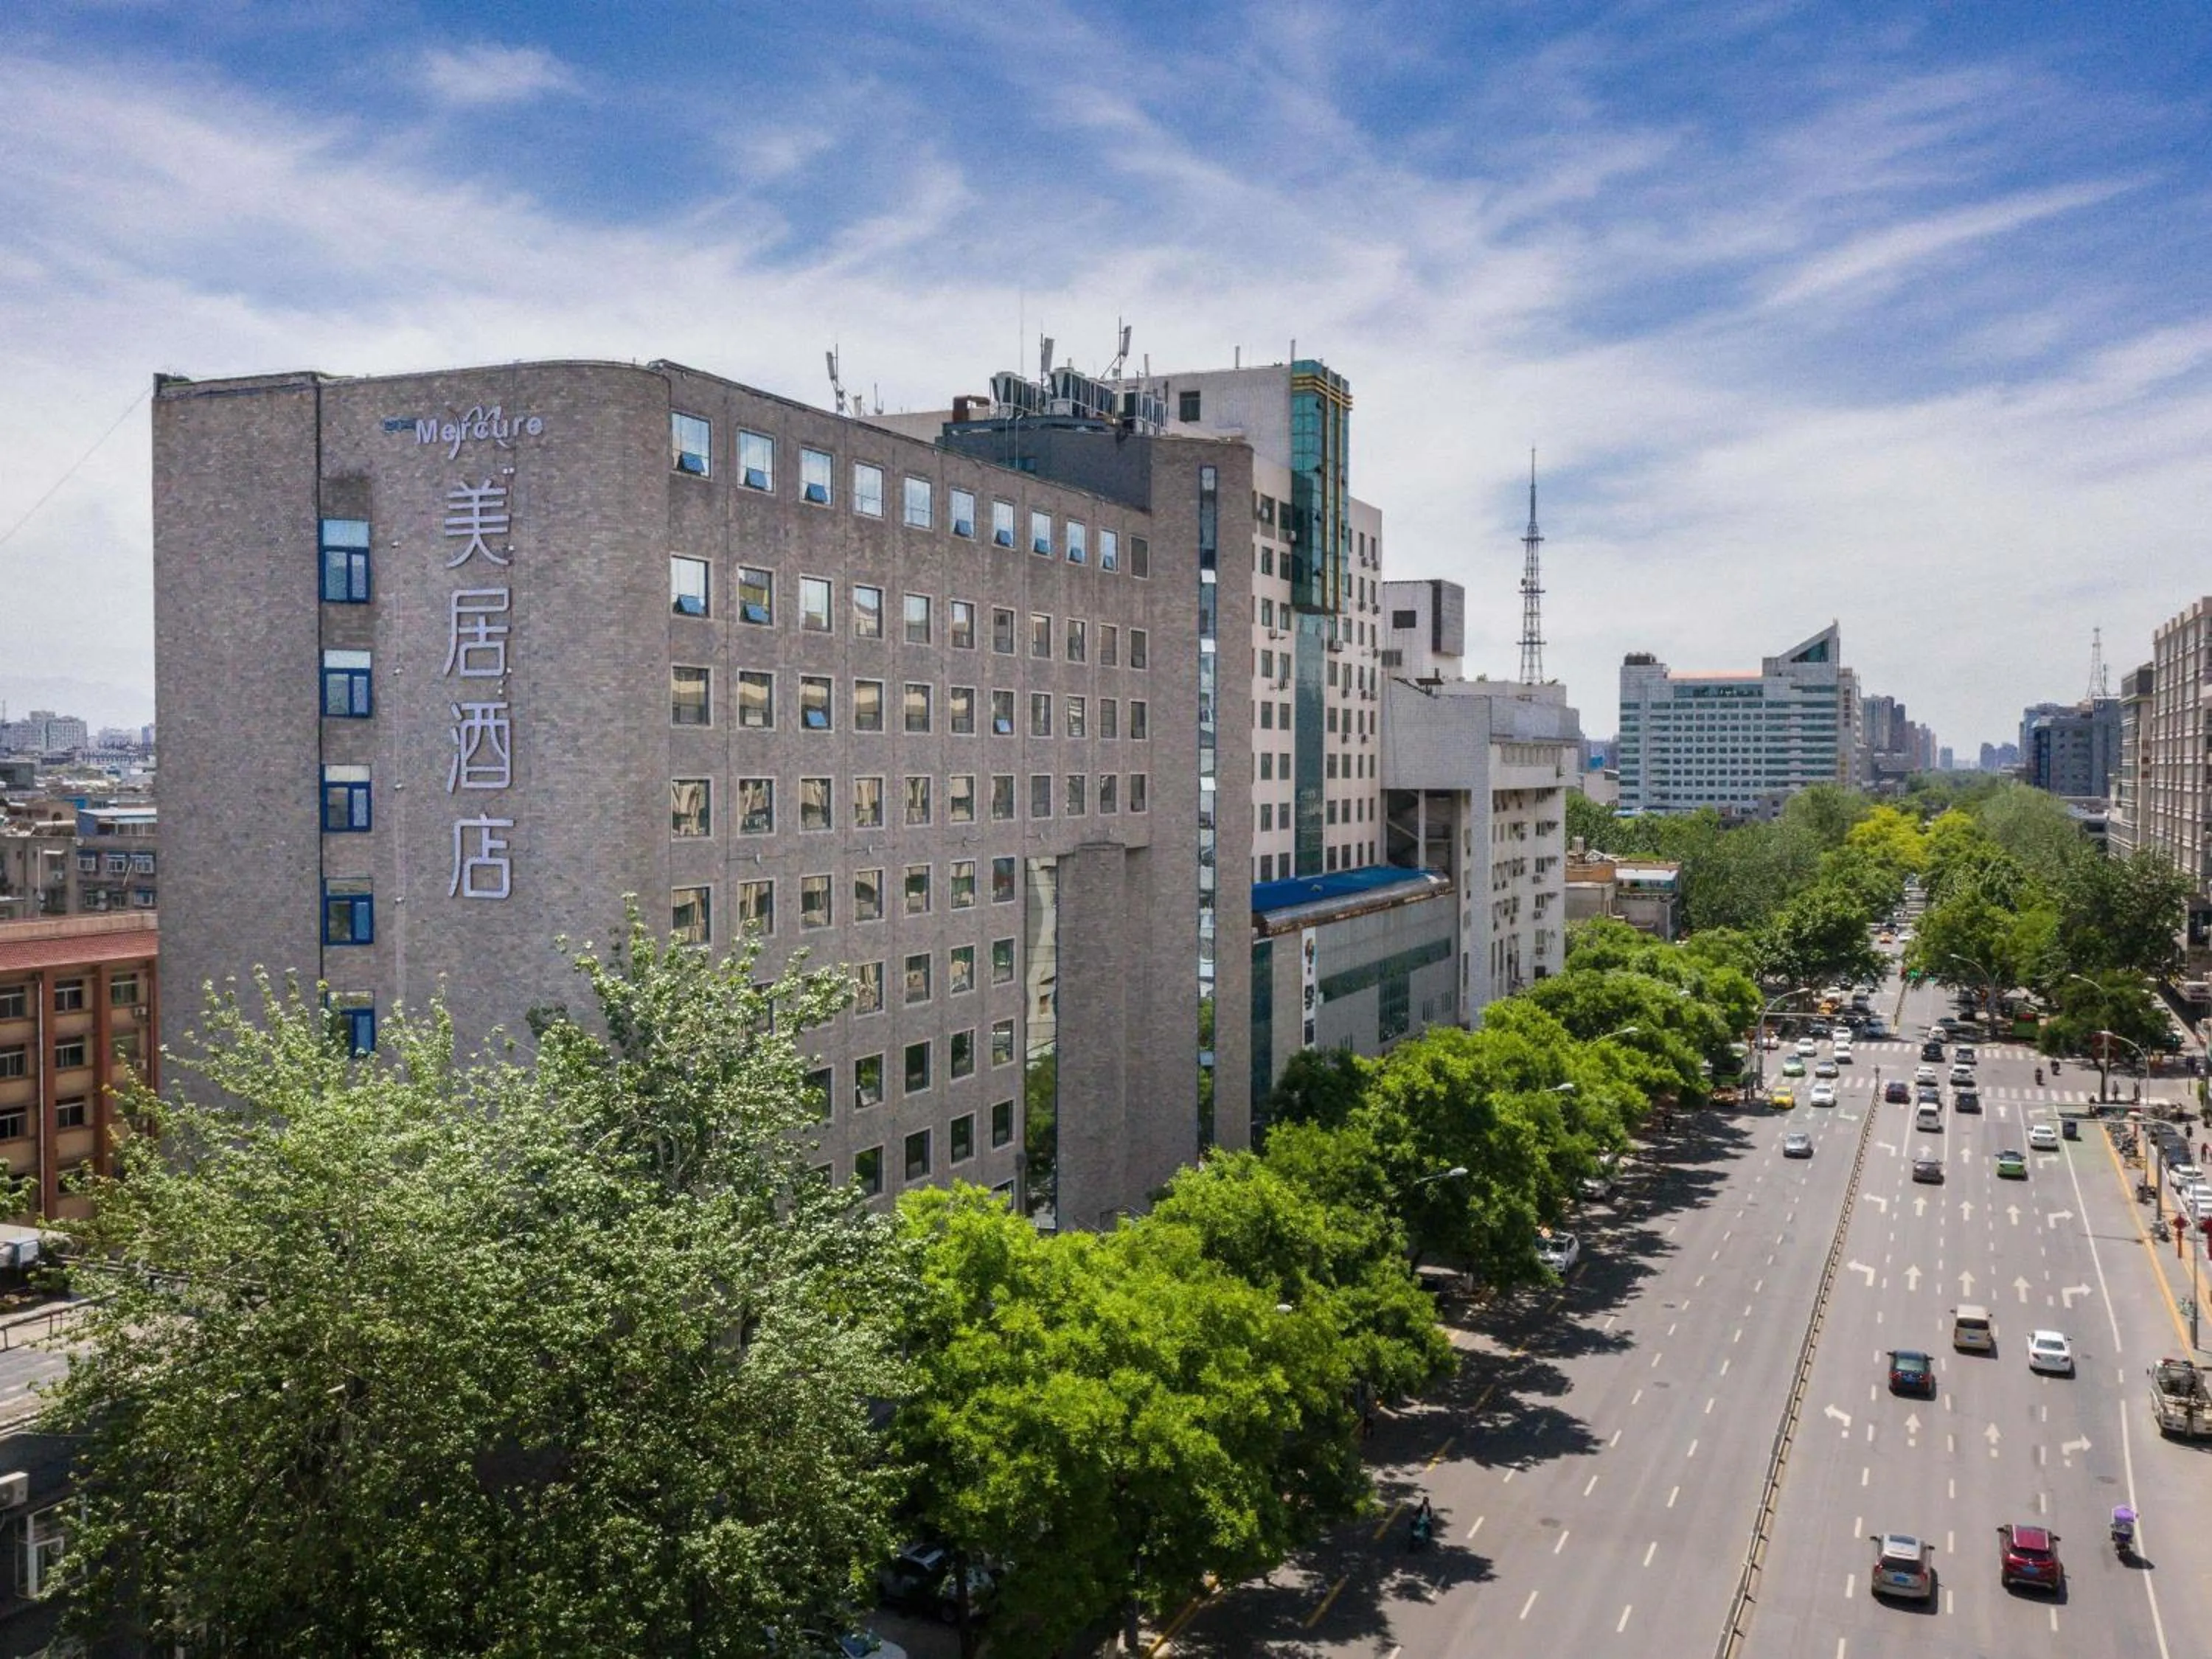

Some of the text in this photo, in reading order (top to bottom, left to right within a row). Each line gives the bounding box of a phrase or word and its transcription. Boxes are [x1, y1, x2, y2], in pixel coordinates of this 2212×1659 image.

[415, 415, 543, 445] Mercure
[442, 479, 514, 898] 美居酒店
